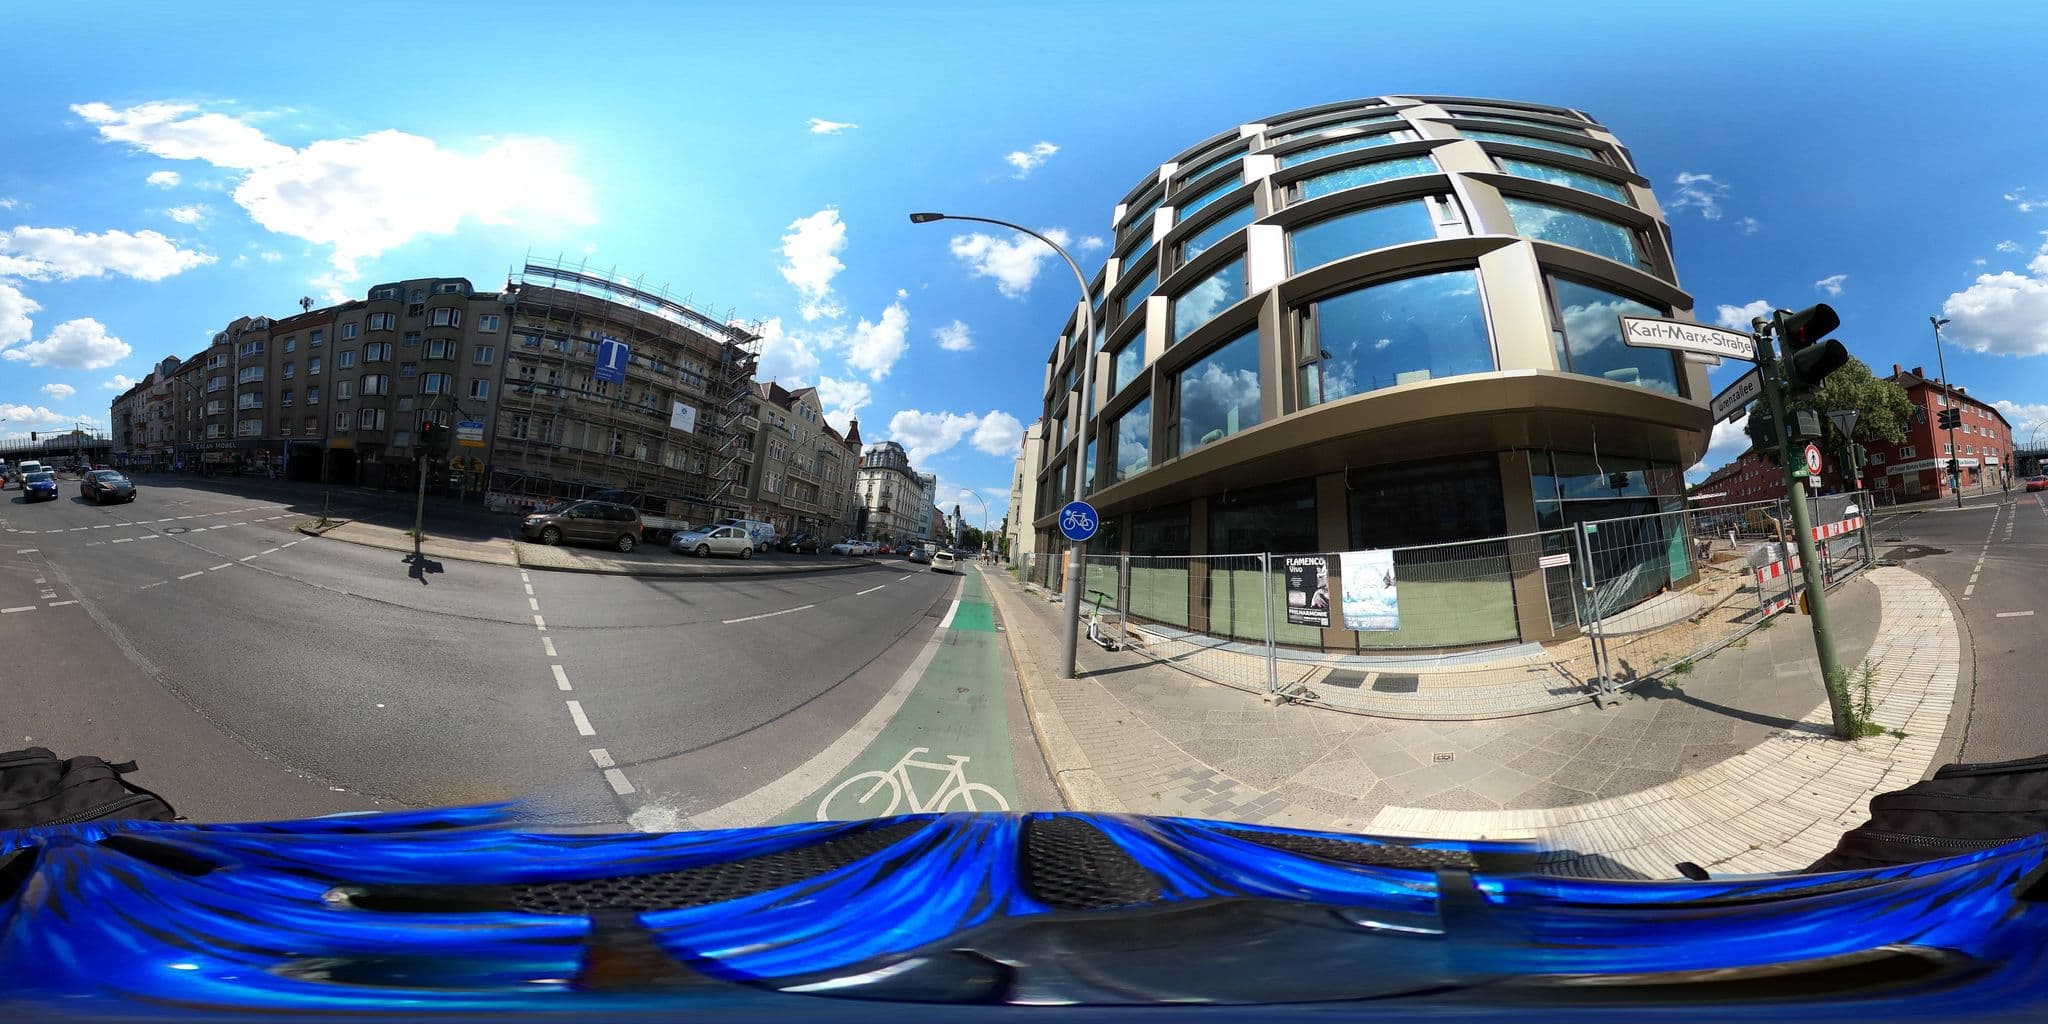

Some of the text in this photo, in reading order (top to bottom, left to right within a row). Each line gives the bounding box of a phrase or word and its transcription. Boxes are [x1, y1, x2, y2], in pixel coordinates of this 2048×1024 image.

[1626, 321, 1752, 353] Karl-Marx-Straße
[602, 338, 628, 369] T
[1719, 382, 1754, 412] Grenzallee
[1286, 557, 1325, 566] FLAMENCO
